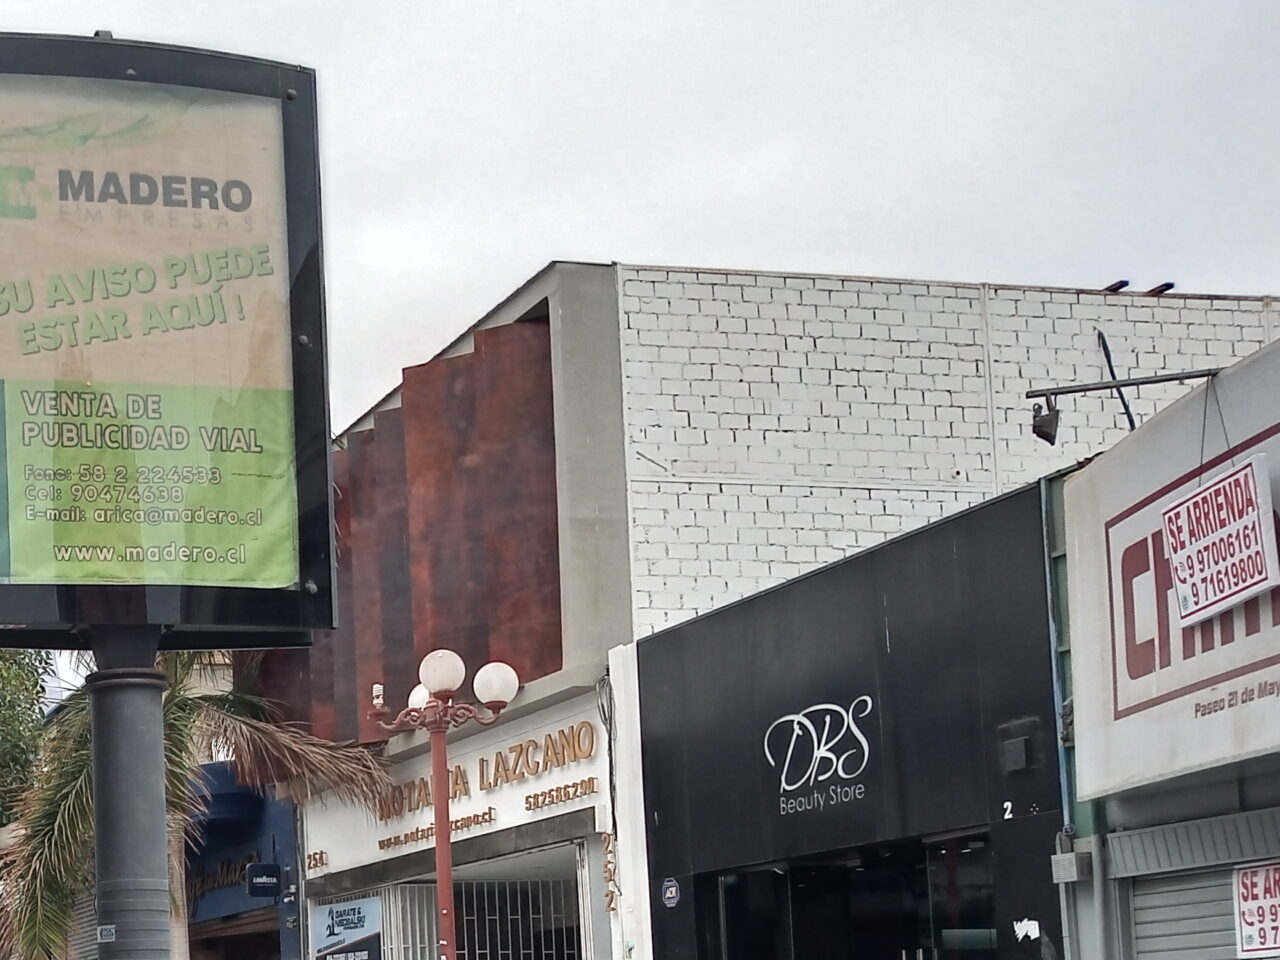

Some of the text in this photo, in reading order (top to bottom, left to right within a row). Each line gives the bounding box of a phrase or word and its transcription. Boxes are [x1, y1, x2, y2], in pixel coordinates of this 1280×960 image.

[57, 169, 253, 213] MADERO
[58, 205, 254, 233] EMPRESAS
[46, 262, 157, 310] AVISO
[166, 244, 274, 289] PUEDE
[18, 308, 131, 355] ESTAR
[22, 391, 162, 419] VENTA DE
[22, 423, 264, 453] PUBLICIDAD VIAL
[79, 466, 106, 482] 58
[115, 466, 128, 482] 2
[136, 467, 222, 485] 224533
[25, 485, 184, 503] Cel: 90474638
[26, 506, 263, 527] E-mail: arica@madero.cl
[1167, 472, 1256, 555] SE ARRIENDA
[54, 543, 247, 565] www.madero.cl
[1186, 520, 1259, 579] 9 97006161
[1191, 550, 1264, 606] 9 71619800
[1194, 698, 1225, 719] Paseo
[1227, 691, 1238, 708] 21
[1241, 687, 1255, 704] de
[764, 695, 873, 793] DBS
[379, 720, 595, 821] NOTAIA LAZCANO
[524, 777, 597, 811] 582586290
[780, 784, 865, 815] Beauty Store
[1002, 801, 1013, 820] 2
[1241, 871, 1259, 902] SE
[1257, 905, 1266, 924] 9
[1258, 927, 1267, 946] 9
